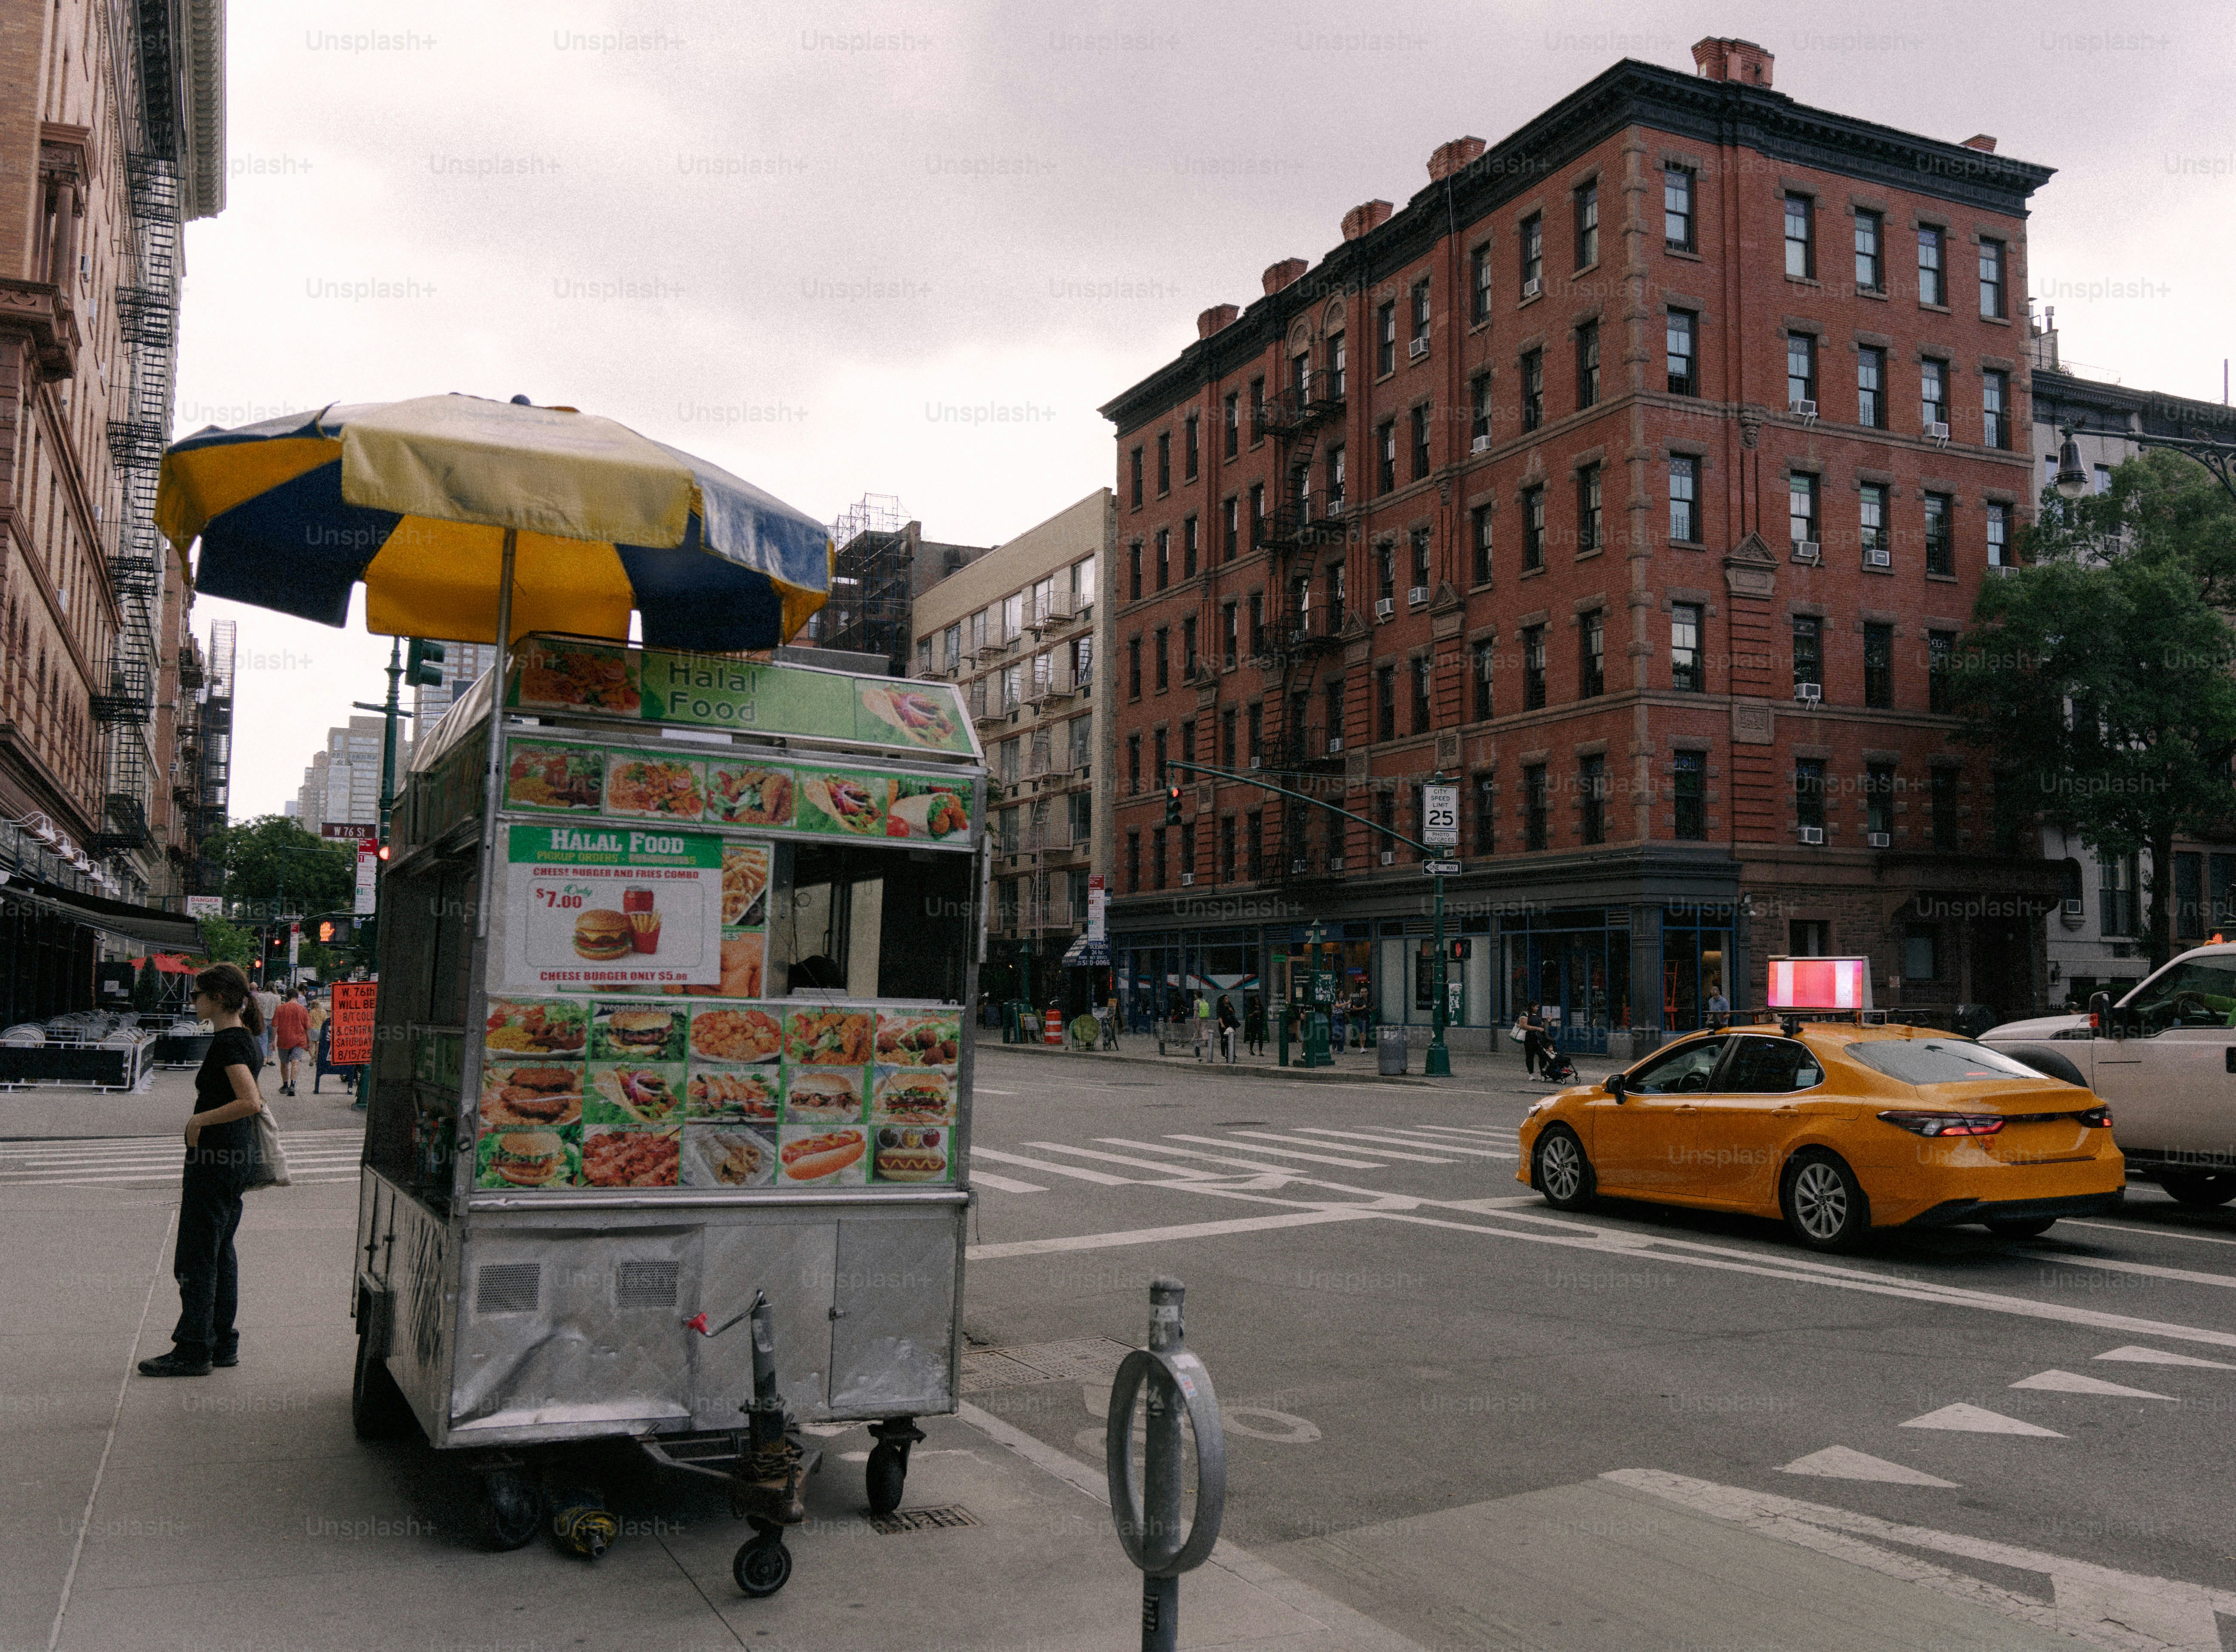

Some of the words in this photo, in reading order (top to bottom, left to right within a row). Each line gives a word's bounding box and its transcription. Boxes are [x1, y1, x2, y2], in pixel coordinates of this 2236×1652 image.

[670, 662, 758, 694] Halal
[669, 691, 756, 723] Food
[1429, 810, 1453, 826] 25
[334, 827, 341, 836] W
[344, 827, 354, 837] 76
[357, 828, 365, 837] St
[551, 829, 623, 852] HALAL
[537, 850, 576, 861] PICKUP
[578, 852, 618, 863] ORDERS
[533, 867, 570, 877] CHEESE
[572, 868, 611, 878] BURGER
[614, 869, 634, 878] AND
[636, 869, 661, 879] FRIES
[664, 870, 699, 879] COMBO
[540, 972, 581, 981] CHEESE
[584, 972, 628, 981] BURGER
[631, 971, 655, 981] ONLY
[658, 971, 687, 981] $5.00
[354, 987, 375, 997] 76th
[339, 1000, 360, 1009] WILL
[363, 999, 375, 1009] BE
[603, 1004, 649, 1014] vegetable
[651, 1004, 683, 1014] burger
[343, 1012, 354, 1022] B/T
[336, 1026, 342, 1036] &
[344, 1025, 373, 1035] CENTRA
[336, 1037, 372, 1047] SATURDAY
[338, 1049, 372, 1060] 8/15/25
